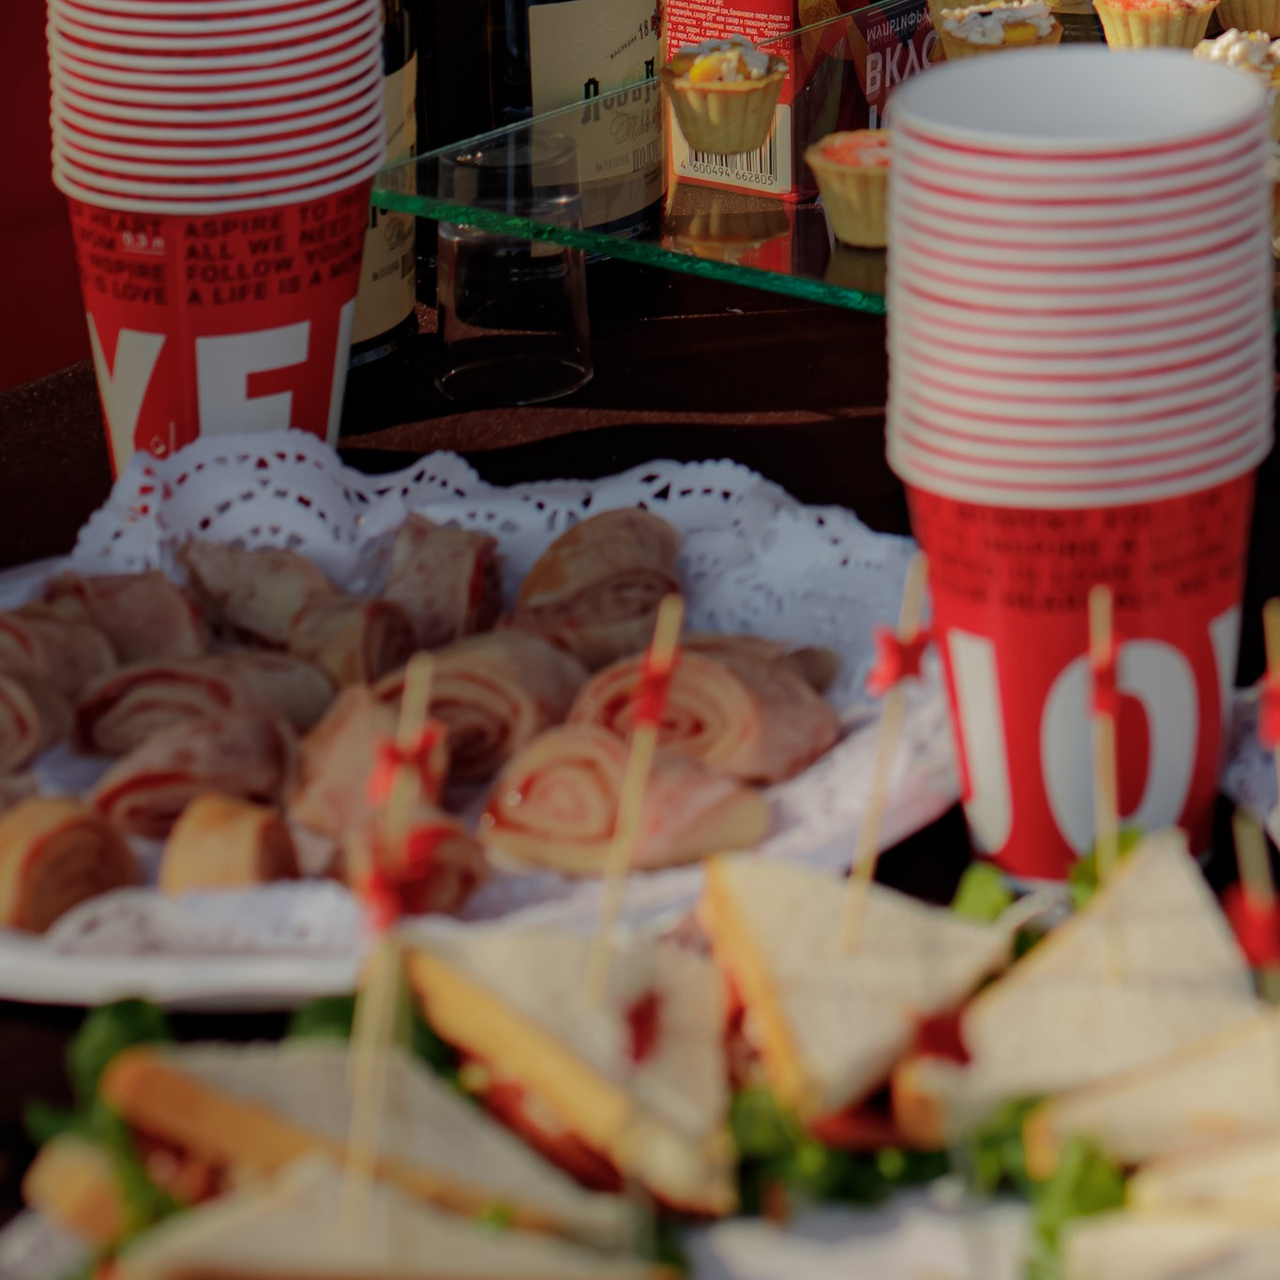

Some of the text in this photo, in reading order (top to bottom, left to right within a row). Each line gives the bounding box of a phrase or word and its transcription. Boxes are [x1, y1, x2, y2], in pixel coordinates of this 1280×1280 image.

[680, 161, 773, 185] 4 600494 662805
[184, 212, 282, 237] ASPIRE
[185, 240, 233, 260] ALL
[186, 257, 295, 284] FOLLOW
